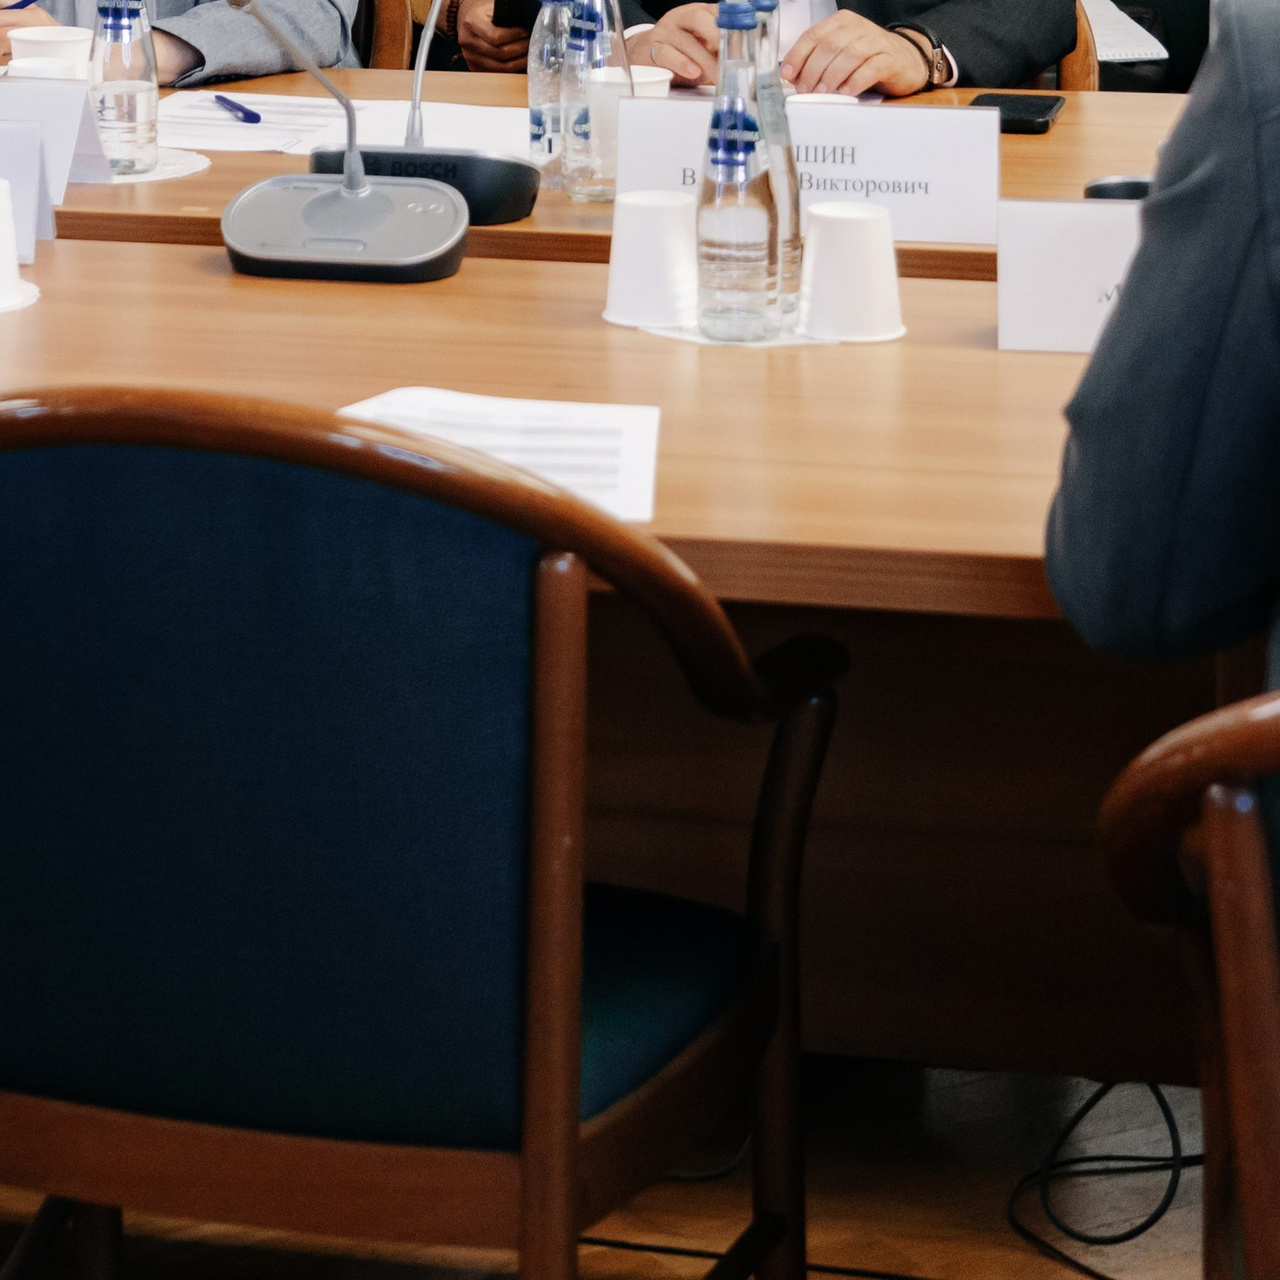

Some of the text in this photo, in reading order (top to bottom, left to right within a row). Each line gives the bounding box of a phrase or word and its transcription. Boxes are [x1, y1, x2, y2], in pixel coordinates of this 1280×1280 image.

[795, 144, 857, 165] ШИН
[391, 159, 458, 178] BOSCH
[798, 171, 930, 197] Викторович
